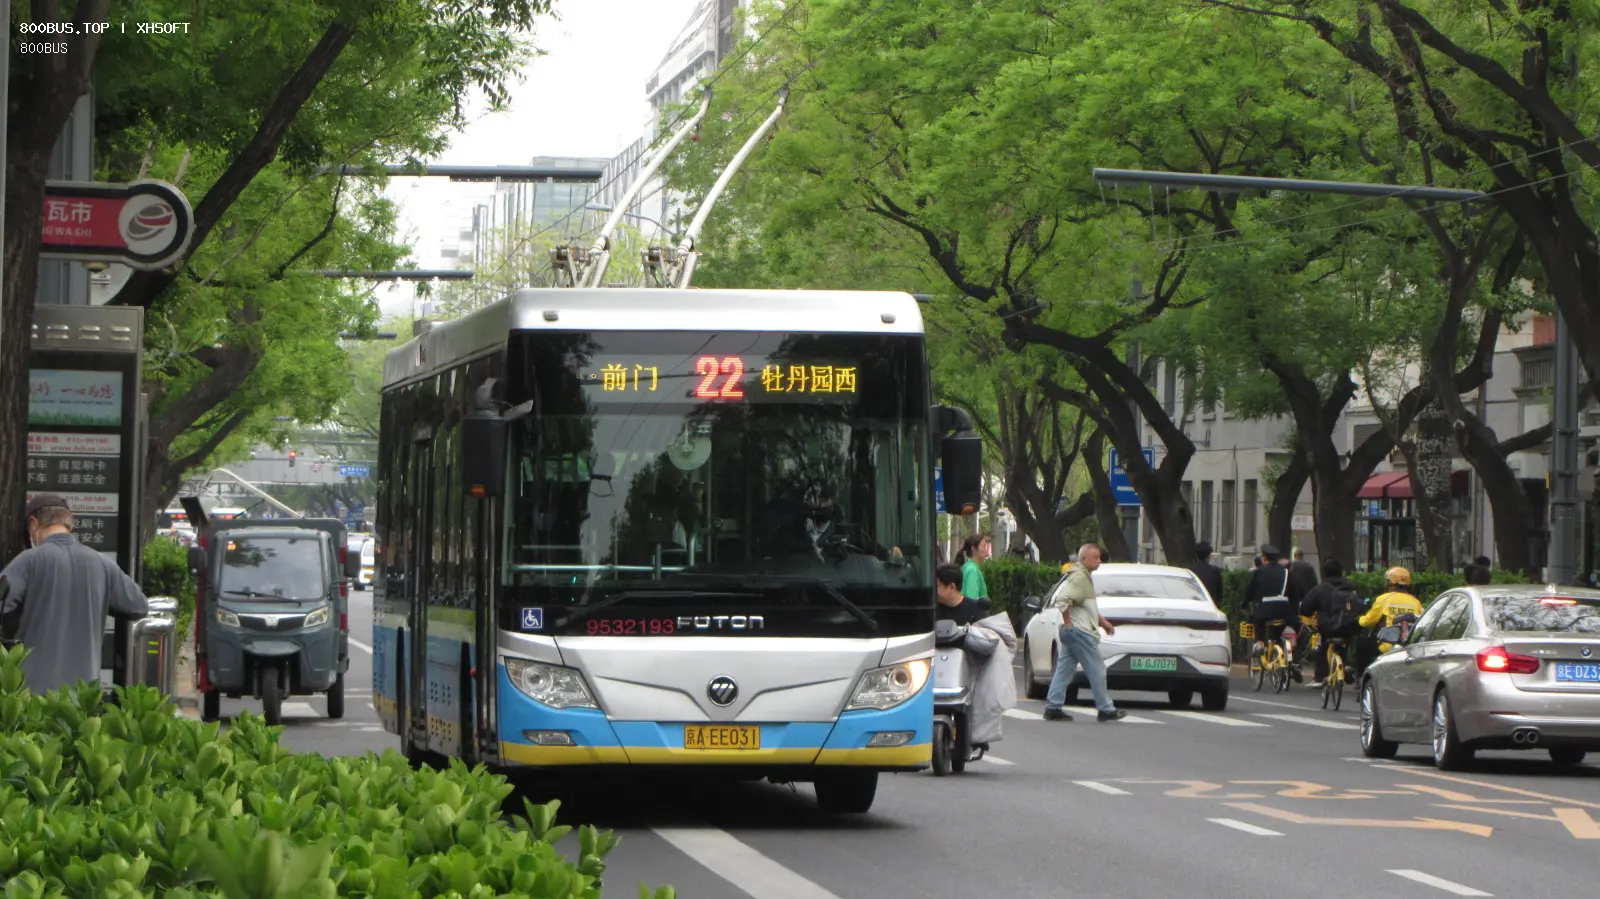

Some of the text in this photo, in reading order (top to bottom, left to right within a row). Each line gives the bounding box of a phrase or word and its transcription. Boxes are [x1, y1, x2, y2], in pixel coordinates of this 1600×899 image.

[600, 363, 658, 392] 前门
[696, 356, 744, 398] 22
[761, 364, 857, 393] 牡丹园西
[58, 473, 106, 485] 注意安全
[586, 619, 675, 636] 9532193
[676, 615, 765, 629] FOTON
